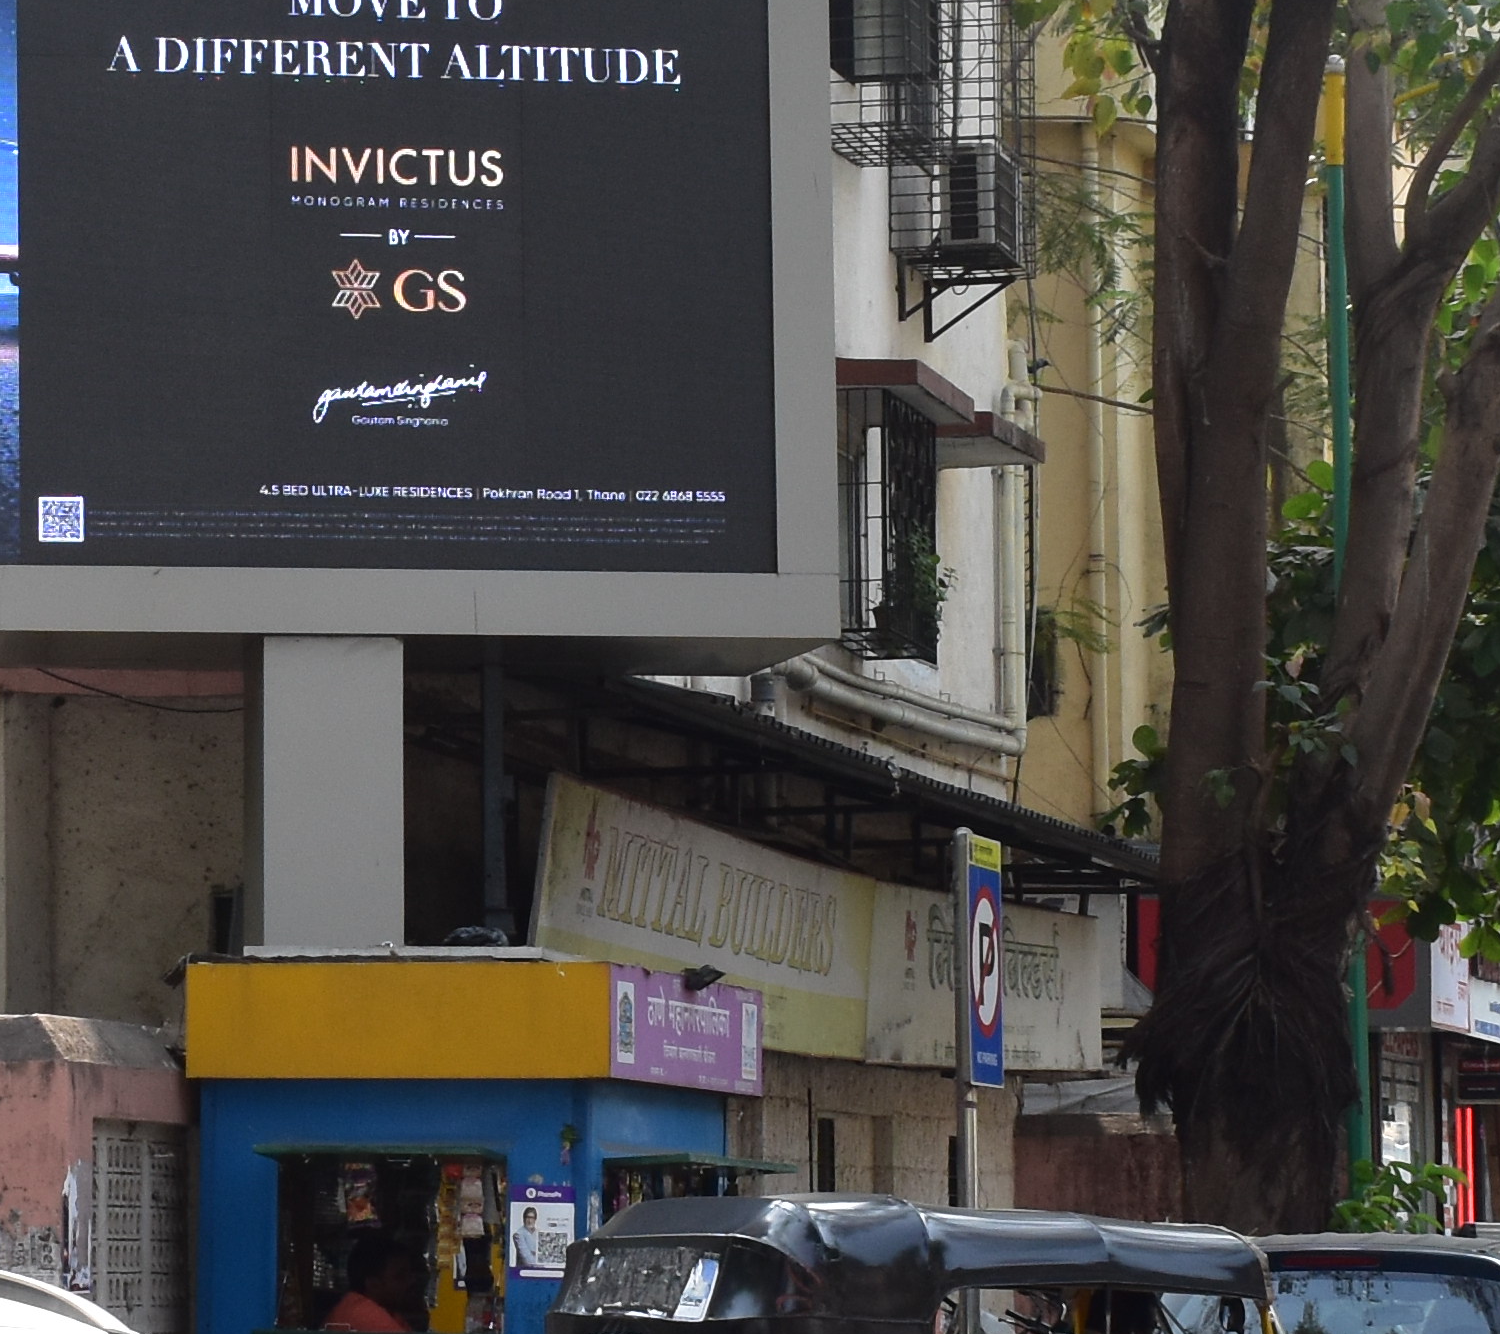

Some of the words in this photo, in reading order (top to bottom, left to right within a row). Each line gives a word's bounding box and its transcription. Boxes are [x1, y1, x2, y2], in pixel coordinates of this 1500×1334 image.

[106, 35, 141, 73] A
[154, 37, 430, 79] DIFFERENT
[441, 43, 682, 86] ALTITUDE
[289, 146, 504, 187] INVICTUS
[291, 195, 390, 209] MONOGRAM
[400, 198, 504, 211] RESIDENCES
[388, 228, 411, 245] BY
[393, 270, 467, 313] GS
[282, 485, 308, 497] BED
[311, 485, 390, 499] ULTRA-LUXE
[392, 486, 473, 499] RESIDENCES
[537, 489, 571, 501] Road
[636, 491, 659, 503] 022
[596, 825, 711, 947] MITTAL
[707, 861, 838, 977] BUILDERS
